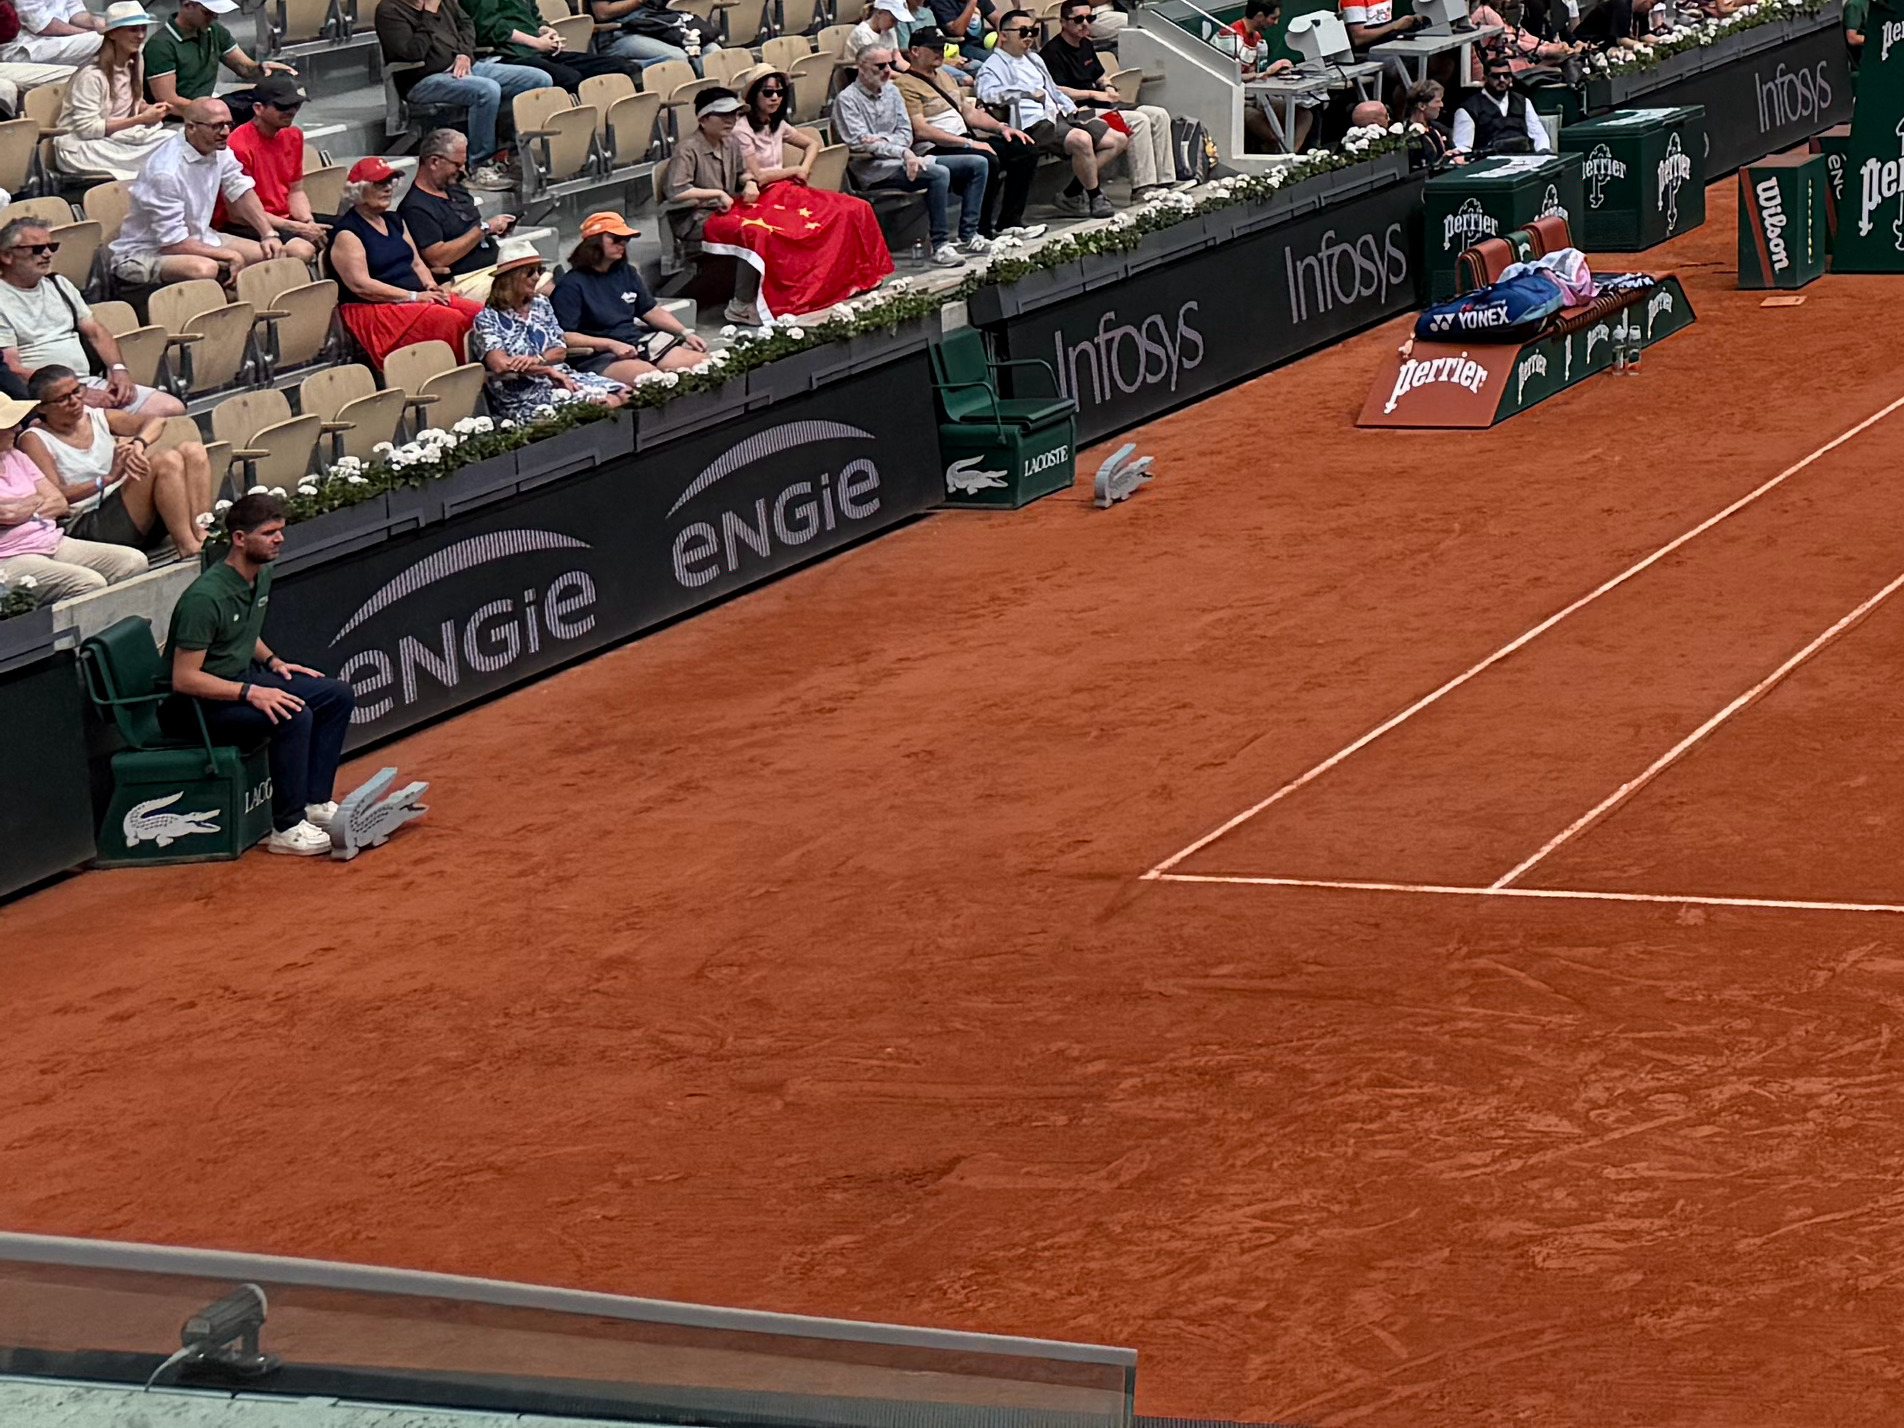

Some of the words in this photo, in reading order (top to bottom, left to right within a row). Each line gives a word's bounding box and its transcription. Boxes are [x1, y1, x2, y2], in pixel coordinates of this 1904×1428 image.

[1755, 60, 1832, 134] Infosys
[1756, 175, 1791, 275] Wilson
[1284, 222, 1407, 325] Infosys
[1457, 304, 1511, 331] YONEX
[1055, 300, 1204, 413] Infosys
[1023, 444, 1070, 479] LACOSTE
[244, 776, 274, 815] LACO
